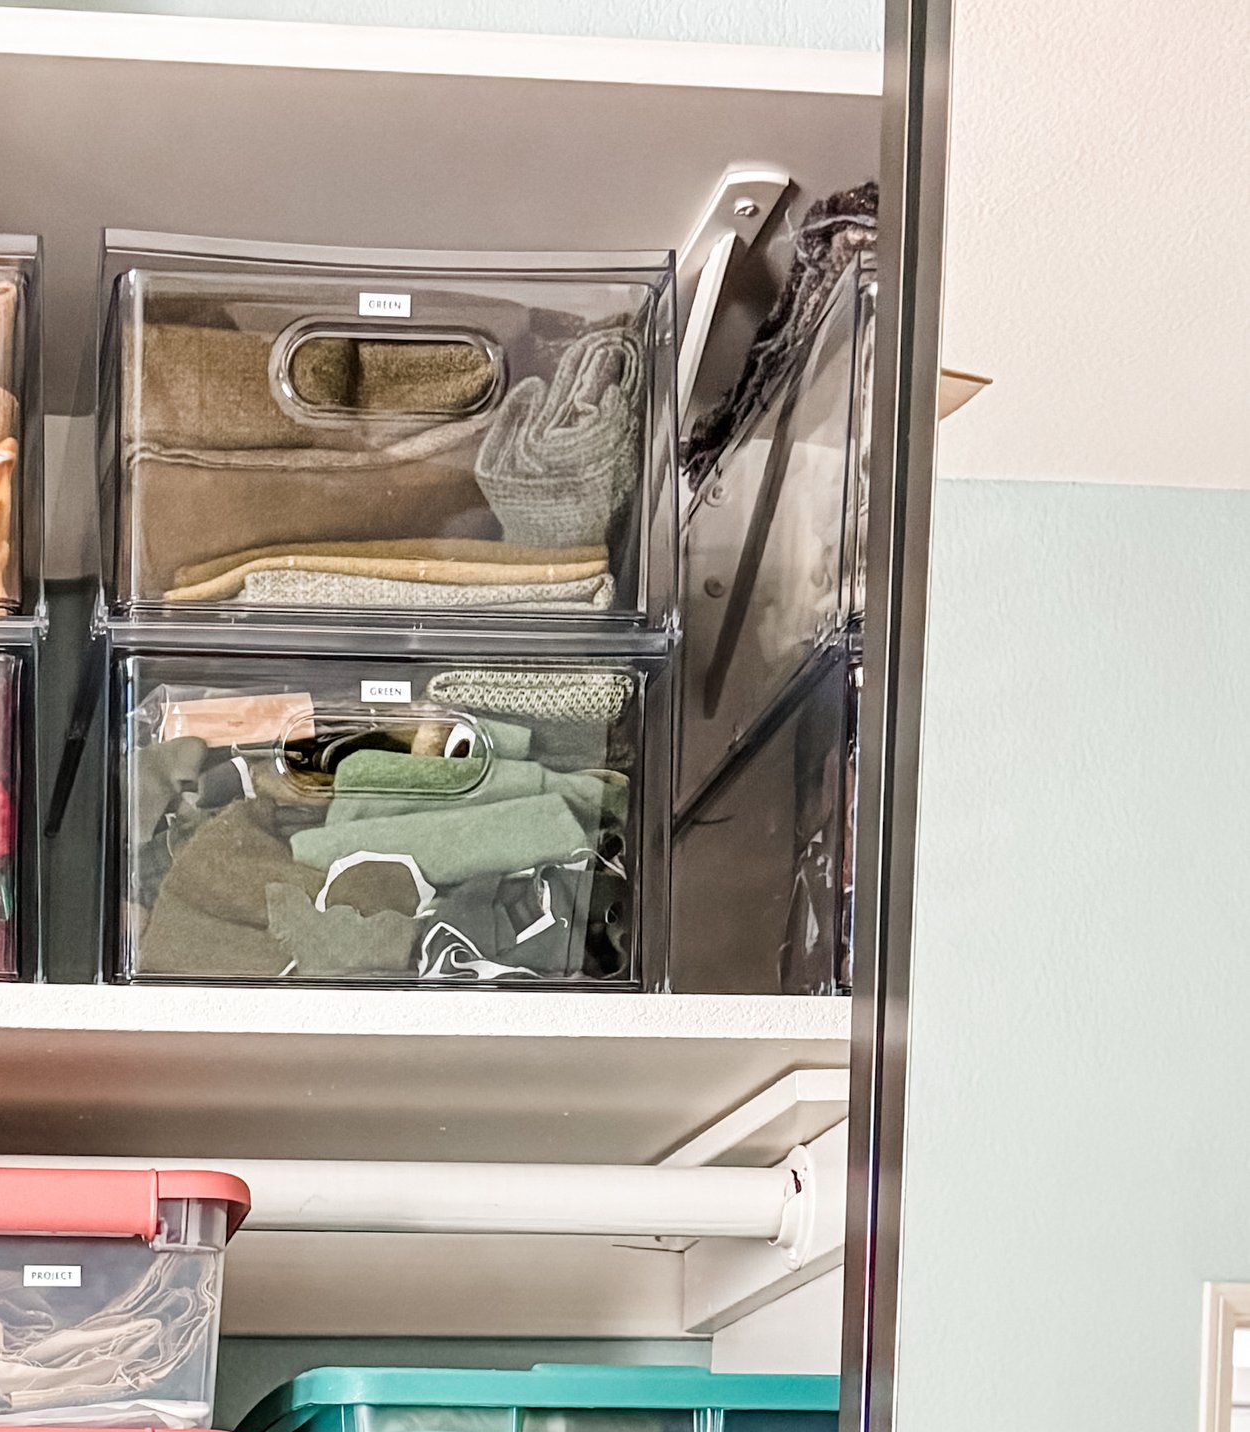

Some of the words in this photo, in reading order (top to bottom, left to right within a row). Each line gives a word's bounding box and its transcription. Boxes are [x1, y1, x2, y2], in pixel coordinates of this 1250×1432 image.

[368, 299, 402, 310] GREEN
[369, 687, 402, 697] GREEN
[31, 1271, 73, 1280] PROJECT
